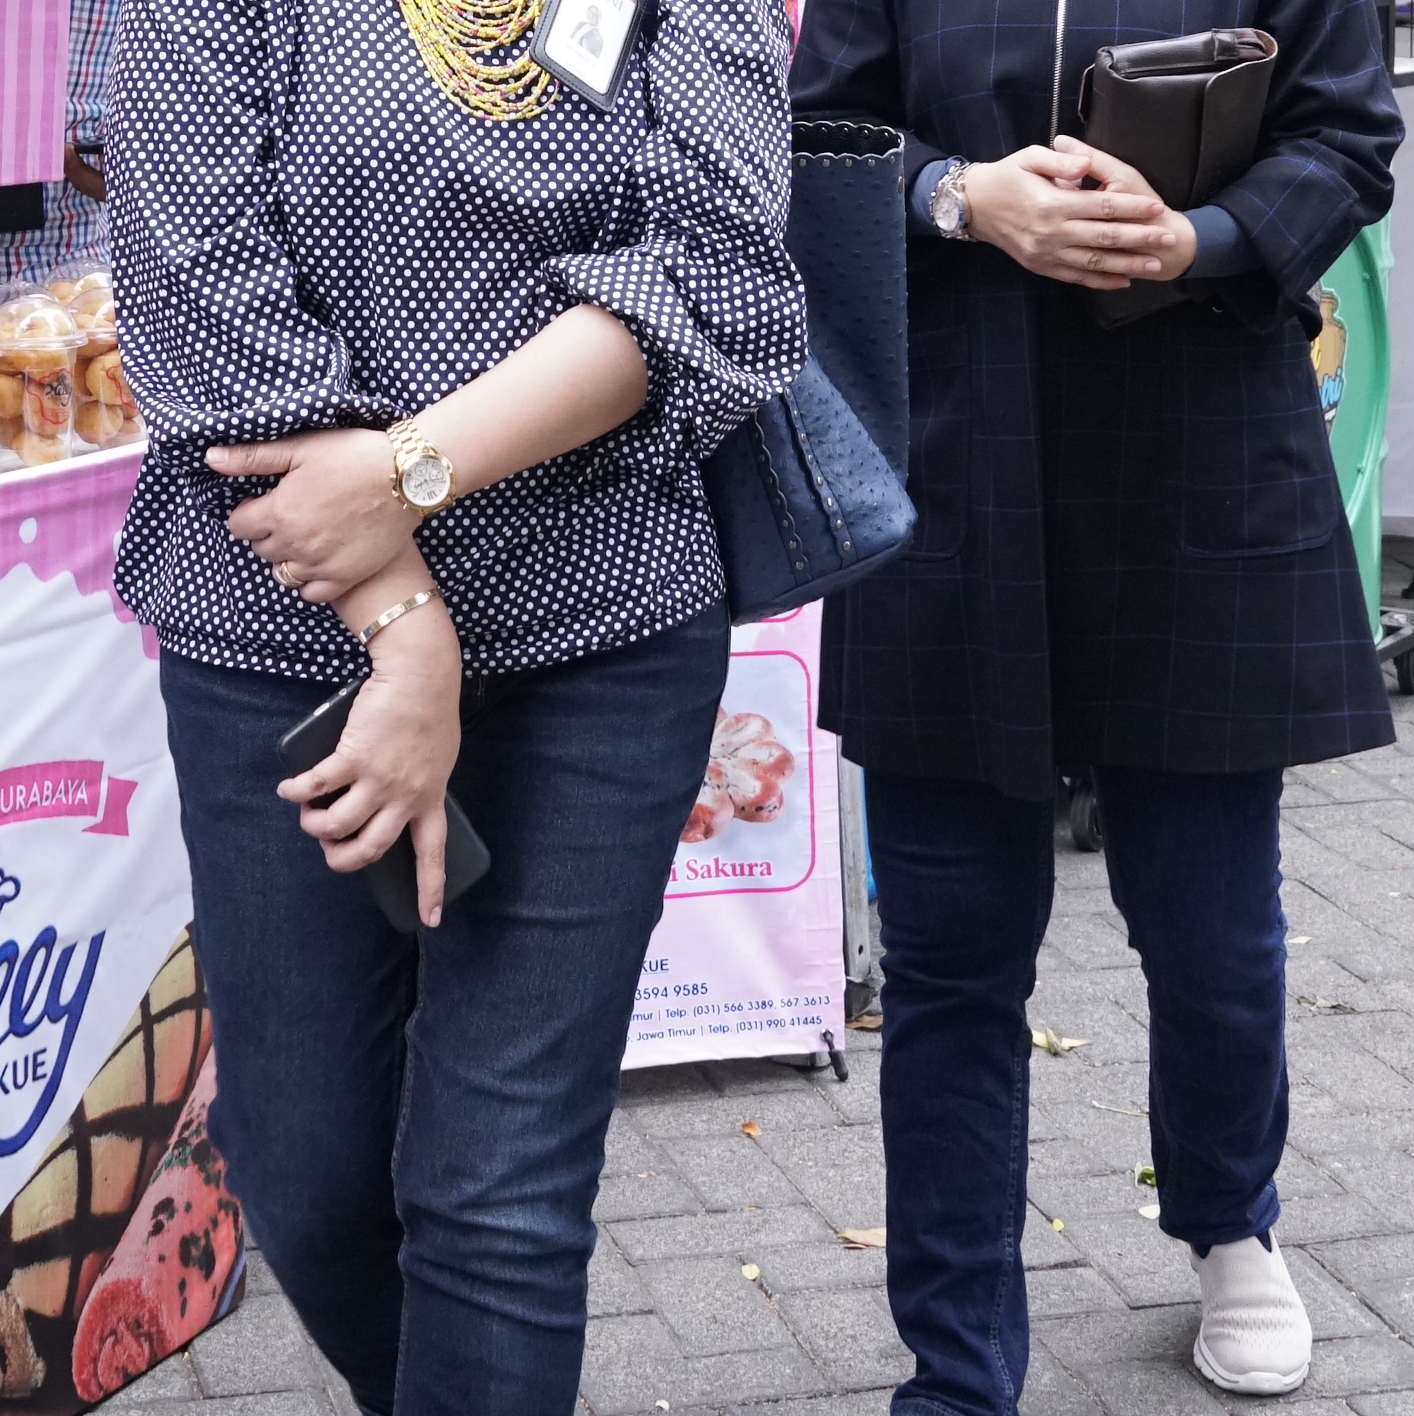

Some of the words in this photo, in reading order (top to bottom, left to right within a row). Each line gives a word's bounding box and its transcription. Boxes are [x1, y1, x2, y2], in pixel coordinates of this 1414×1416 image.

[686, 855, 773, 883] Sakura
[673, 983, 708, 997] 9585
[666, 1008, 690, 1019] Telp.
[693, 1005, 721, 1017] (031)
[724, 1002, 744, 1012] 566
[780, 997, 799, 1008] 567
[804, 996, 830, 1007] 3613
[637, 1031, 665, 1041] Jawa
[668, 1028, 696, 1038] Timur
[708, 1024, 733, 1036] Telp.
[736, 1022, 763, 1034] (031)
[766, 1018, 786, 1029] 990
[790, 1016, 823, 1027] 41445
